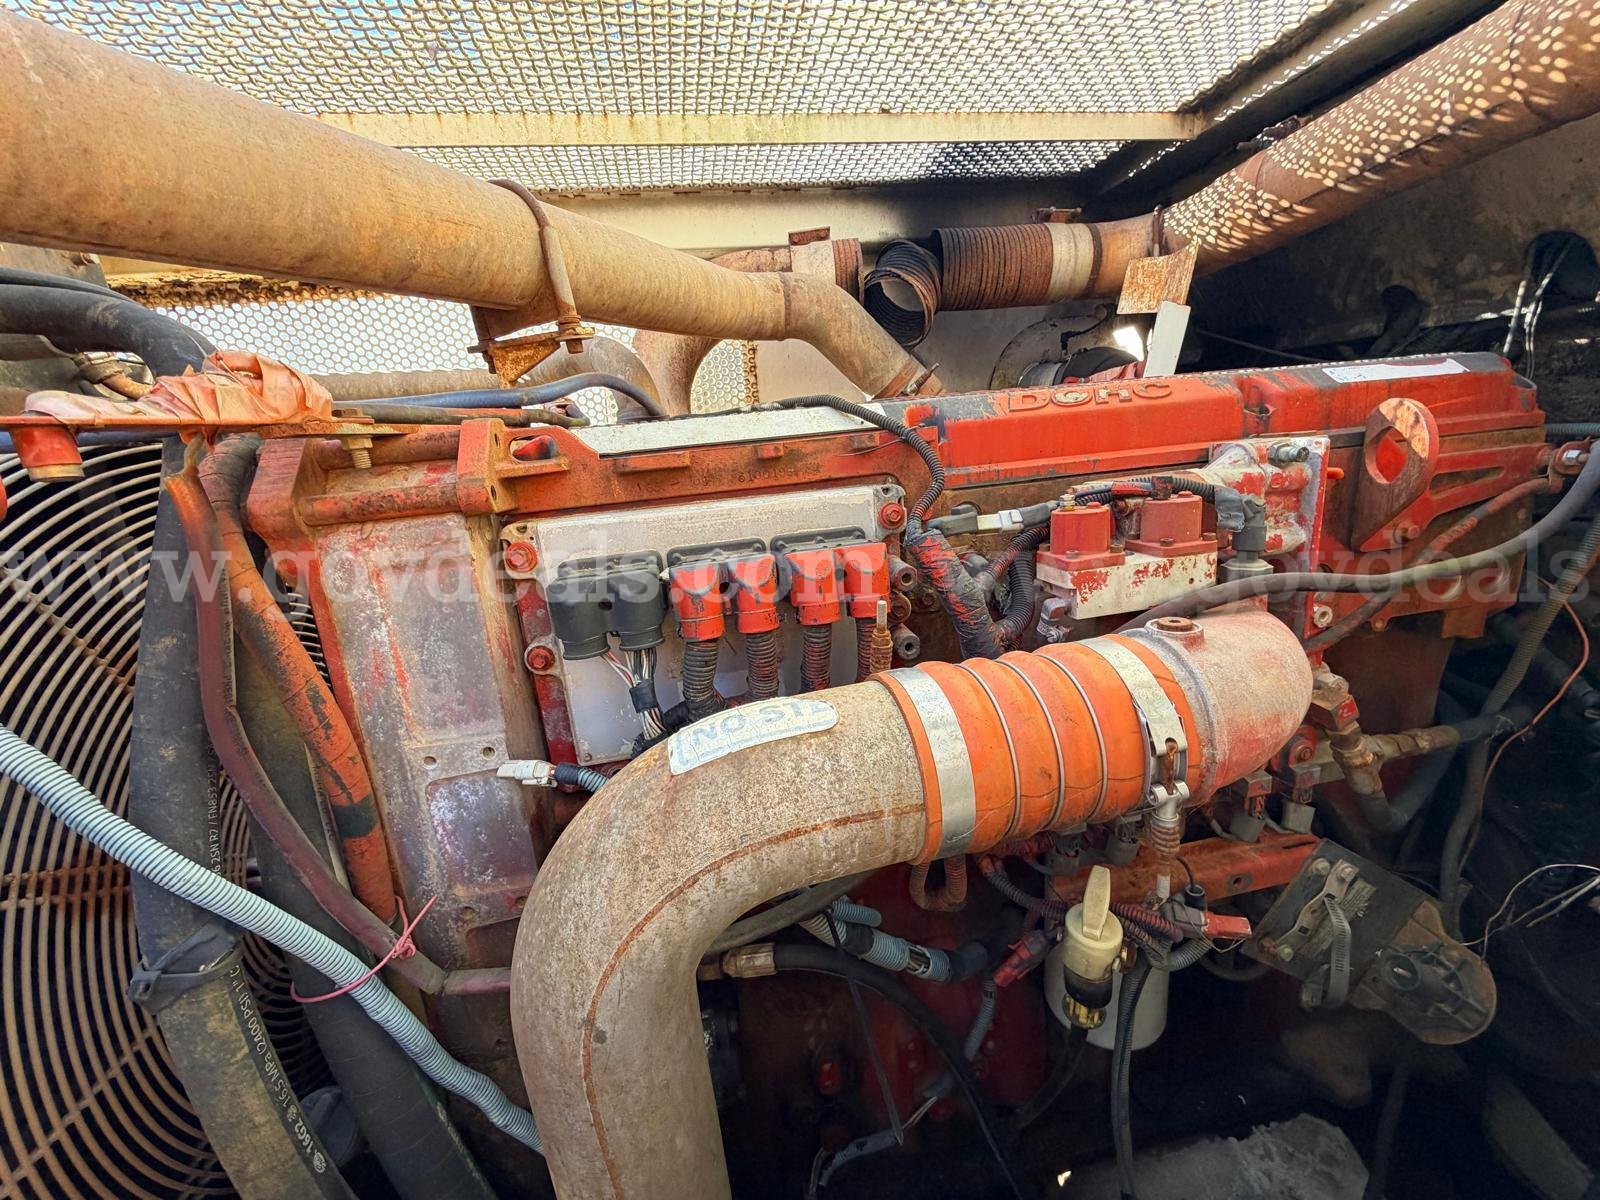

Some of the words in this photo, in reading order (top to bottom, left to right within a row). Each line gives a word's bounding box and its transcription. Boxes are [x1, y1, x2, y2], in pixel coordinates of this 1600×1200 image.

[1009, 381, 1172, 413] DOHC
[692, 714, 747, 746] NO
[209, 829, 218, 842] R2
[209, 843, 220, 863] 2SN
[239, 992, 254, 1019] PSI)
[248, 1017, 267, 1055] (2400
[264, 1052, 280, 1082] MPa
[294, 1117, 314, 1154] 16G2
